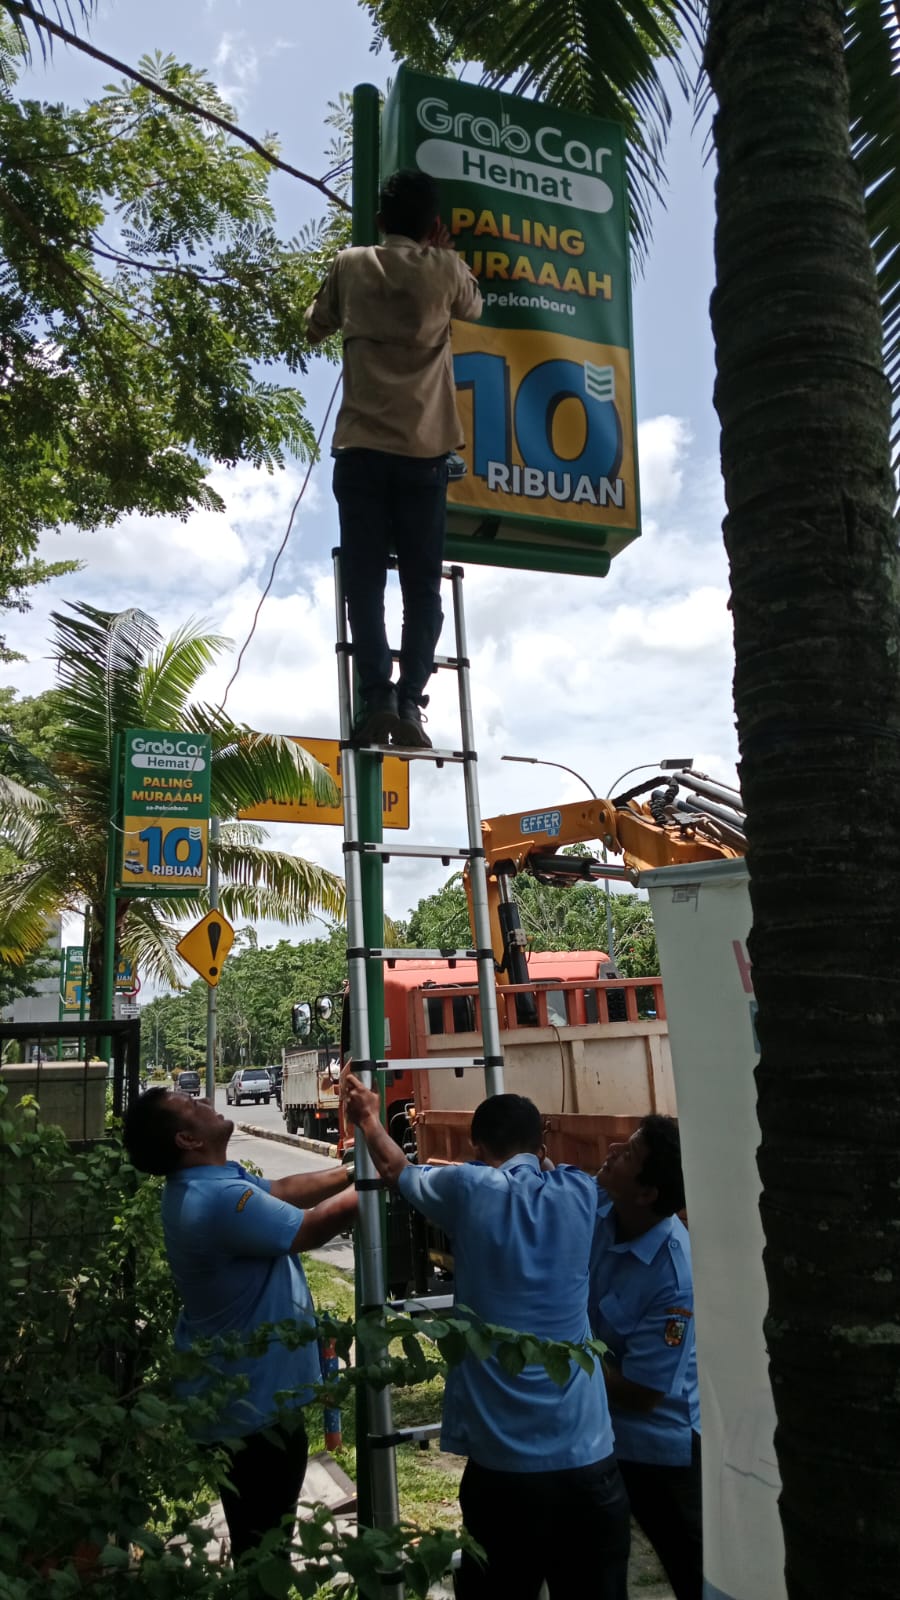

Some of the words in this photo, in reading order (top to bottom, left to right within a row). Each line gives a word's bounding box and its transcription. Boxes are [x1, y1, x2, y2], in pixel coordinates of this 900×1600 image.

[416, 97, 612, 174] GrabCar
[463, 150, 573, 201] Hemat
[451, 207, 585, 256] PALING
[462, 250, 613, 300] URAAAH
[481, 292, 577, 316] -Pekanbaru
[453, 351, 622, 481] 10
[487, 461, 625, 508] RIBUAN
[131, 737, 206, 757] GrabCar
[147, 756, 190, 769] Hemat
[131, 790, 203, 803] MURAAAH
[143, 776, 193, 789] PALING
[522, 812, 560, 831] EFFER
[139, 826, 203, 872] 10
[151, 865, 203, 877] RIBUAN
